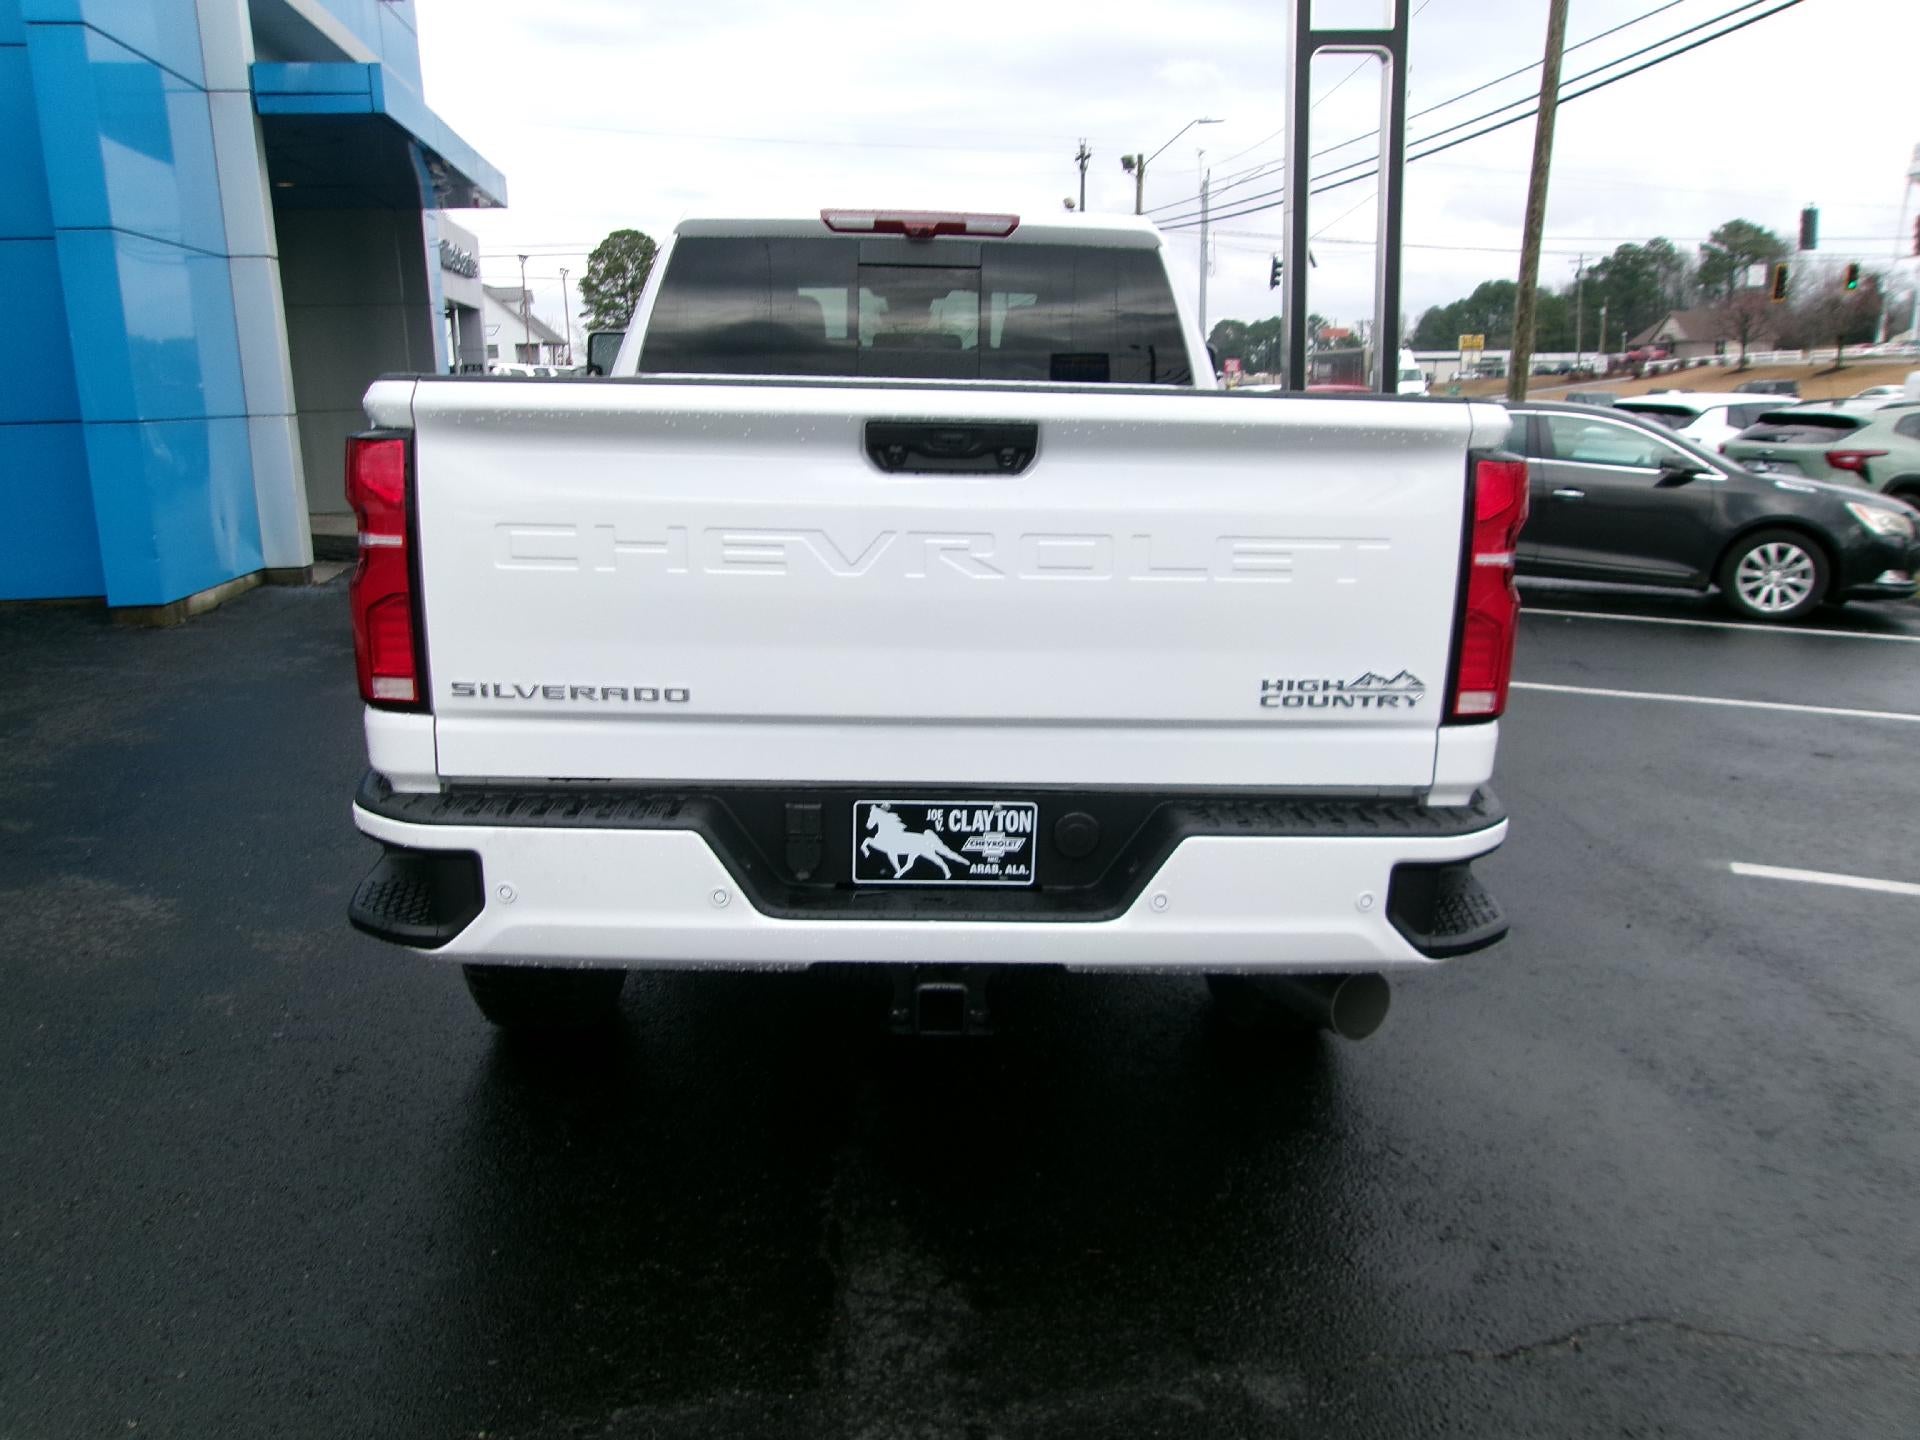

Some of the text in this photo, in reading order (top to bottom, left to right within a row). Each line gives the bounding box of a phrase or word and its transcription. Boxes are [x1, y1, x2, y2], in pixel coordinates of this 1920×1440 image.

[494, 522, 1391, 584] CHEVROLET
[451, 681, 690, 703] SILVERADO
[1262, 679, 1346, 692] HIGH
[1260, 694, 1424, 708] COUNTRY
[926, 808, 944, 821] JOE
[948, 808, 1033, 833] CLAYTON
[969, 839, 1018, 848] CHEVROLET
